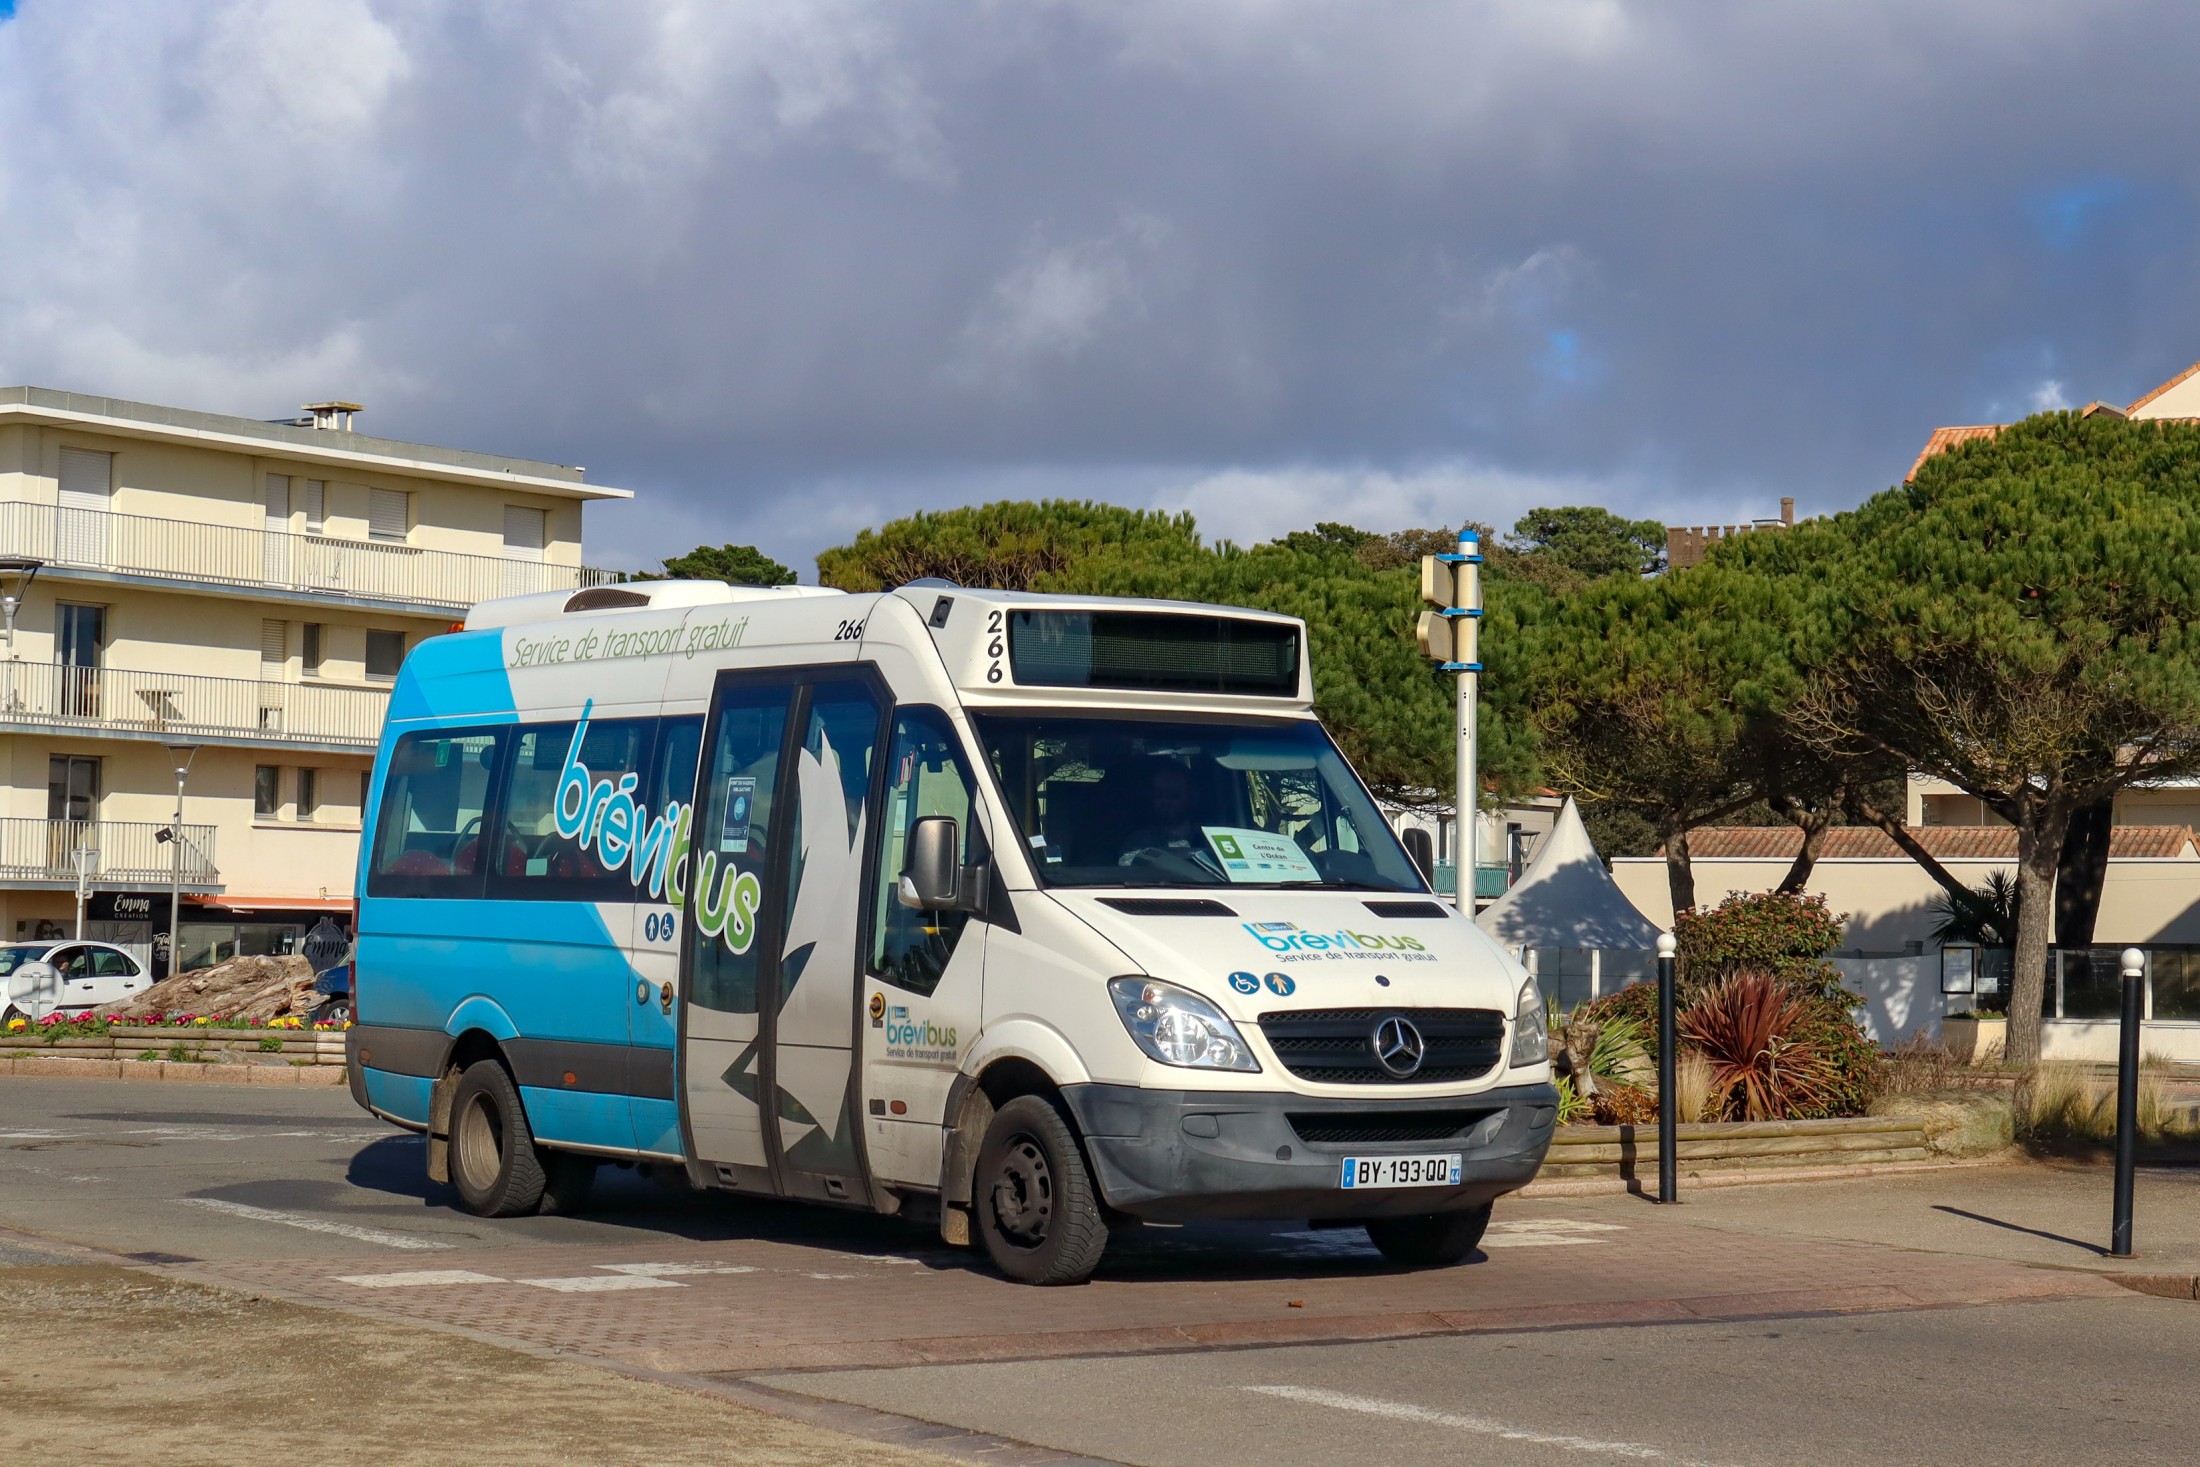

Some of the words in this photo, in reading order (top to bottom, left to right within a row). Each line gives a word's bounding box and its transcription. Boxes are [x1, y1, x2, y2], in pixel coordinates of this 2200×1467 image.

[510, 635, 570, 668] Service
[574, 628, 599, 661] de
[602, 622, 686, 663] transport
[686, 616, 750, 661] gratuit
[834, 619, 865, 641] 266
[987, 610, 1004, 683] 266
[114, 894, 150, 912] Emma
[1242, 923, 1426, 951] brévibus
[1275, 953, 1322, 963] Service
[1325, 951, 1343, 960] de
[1344, 951, 1400, 961] transport
[1401, 953, 1438, 963] gratuit
[886, 1006, 957, 1047] brévibus
[886, 1047, 905, 1057] Service
[906, 1047, 914, 1057] de
[915, 1048, 940, 1060] transport
[1358, 1159, 1447, 1184] BY-193-QQ
[1450, 1170, 1459, 1182] 44
